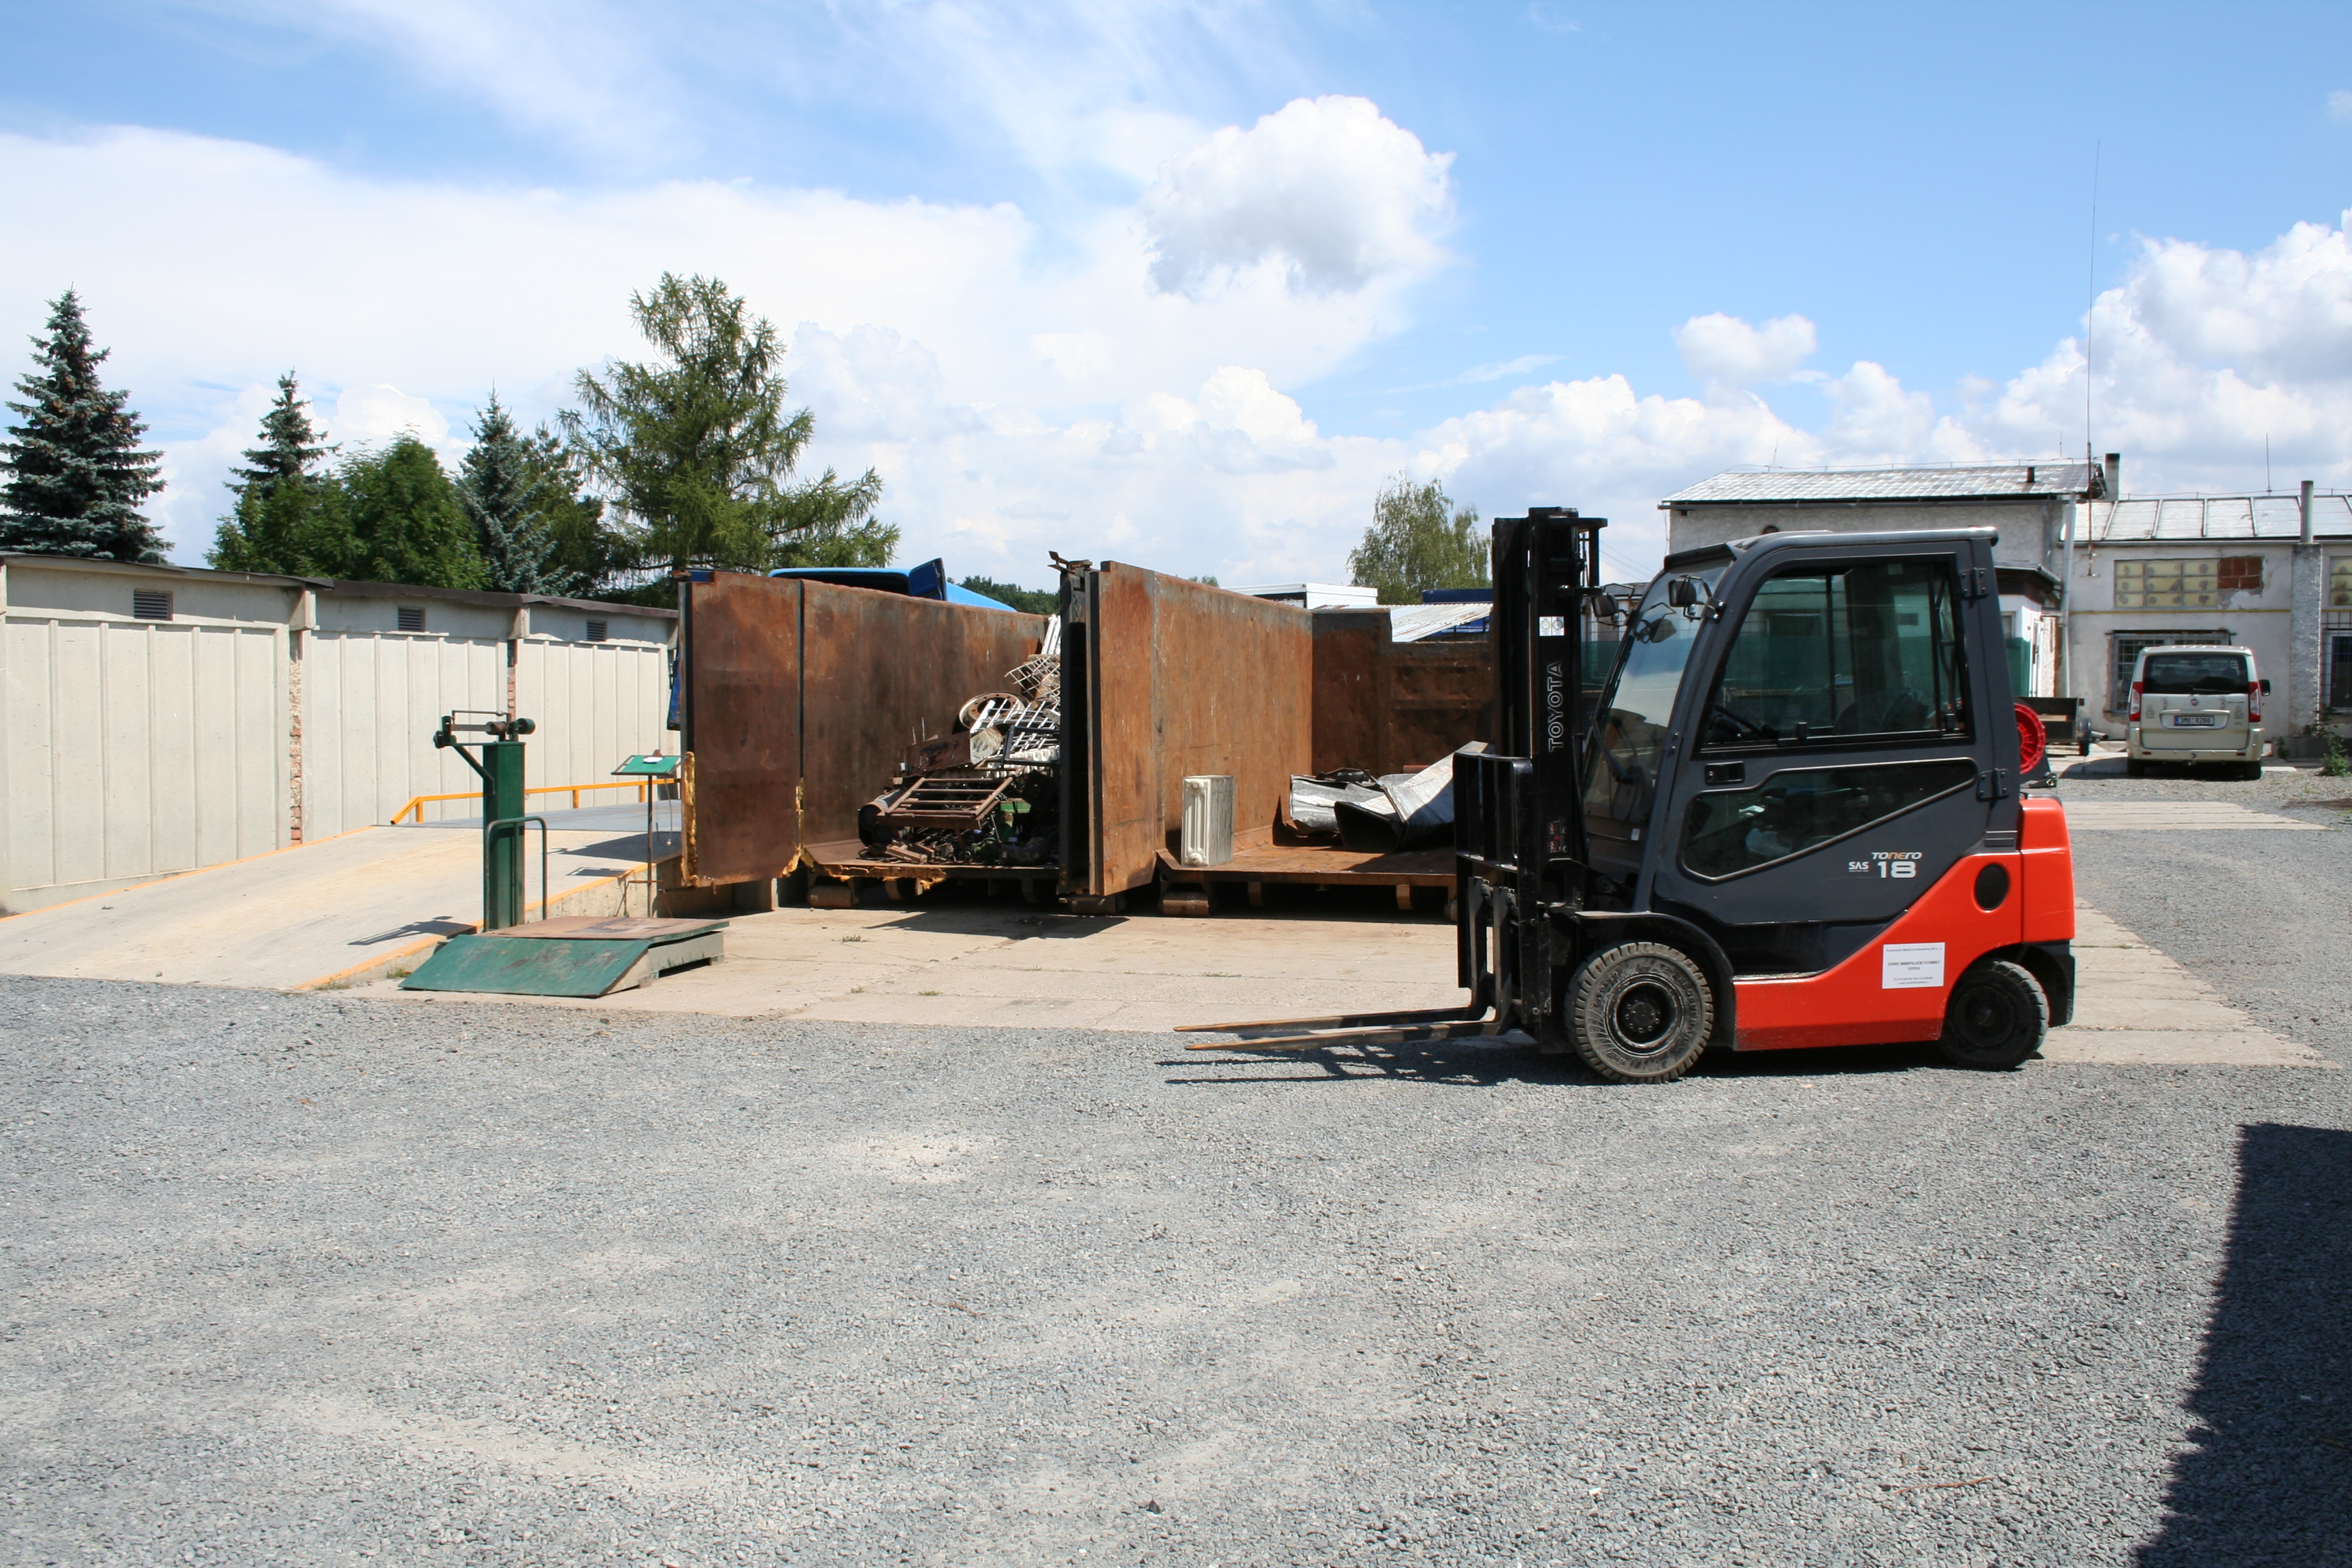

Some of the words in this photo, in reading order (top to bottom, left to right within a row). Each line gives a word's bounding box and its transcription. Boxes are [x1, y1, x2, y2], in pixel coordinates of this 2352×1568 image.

[1547, 661, 1564, 752] TOYOTA
[1848, 861, 1869, 870] SAS
[1877, 861, 1916, 879] 18
